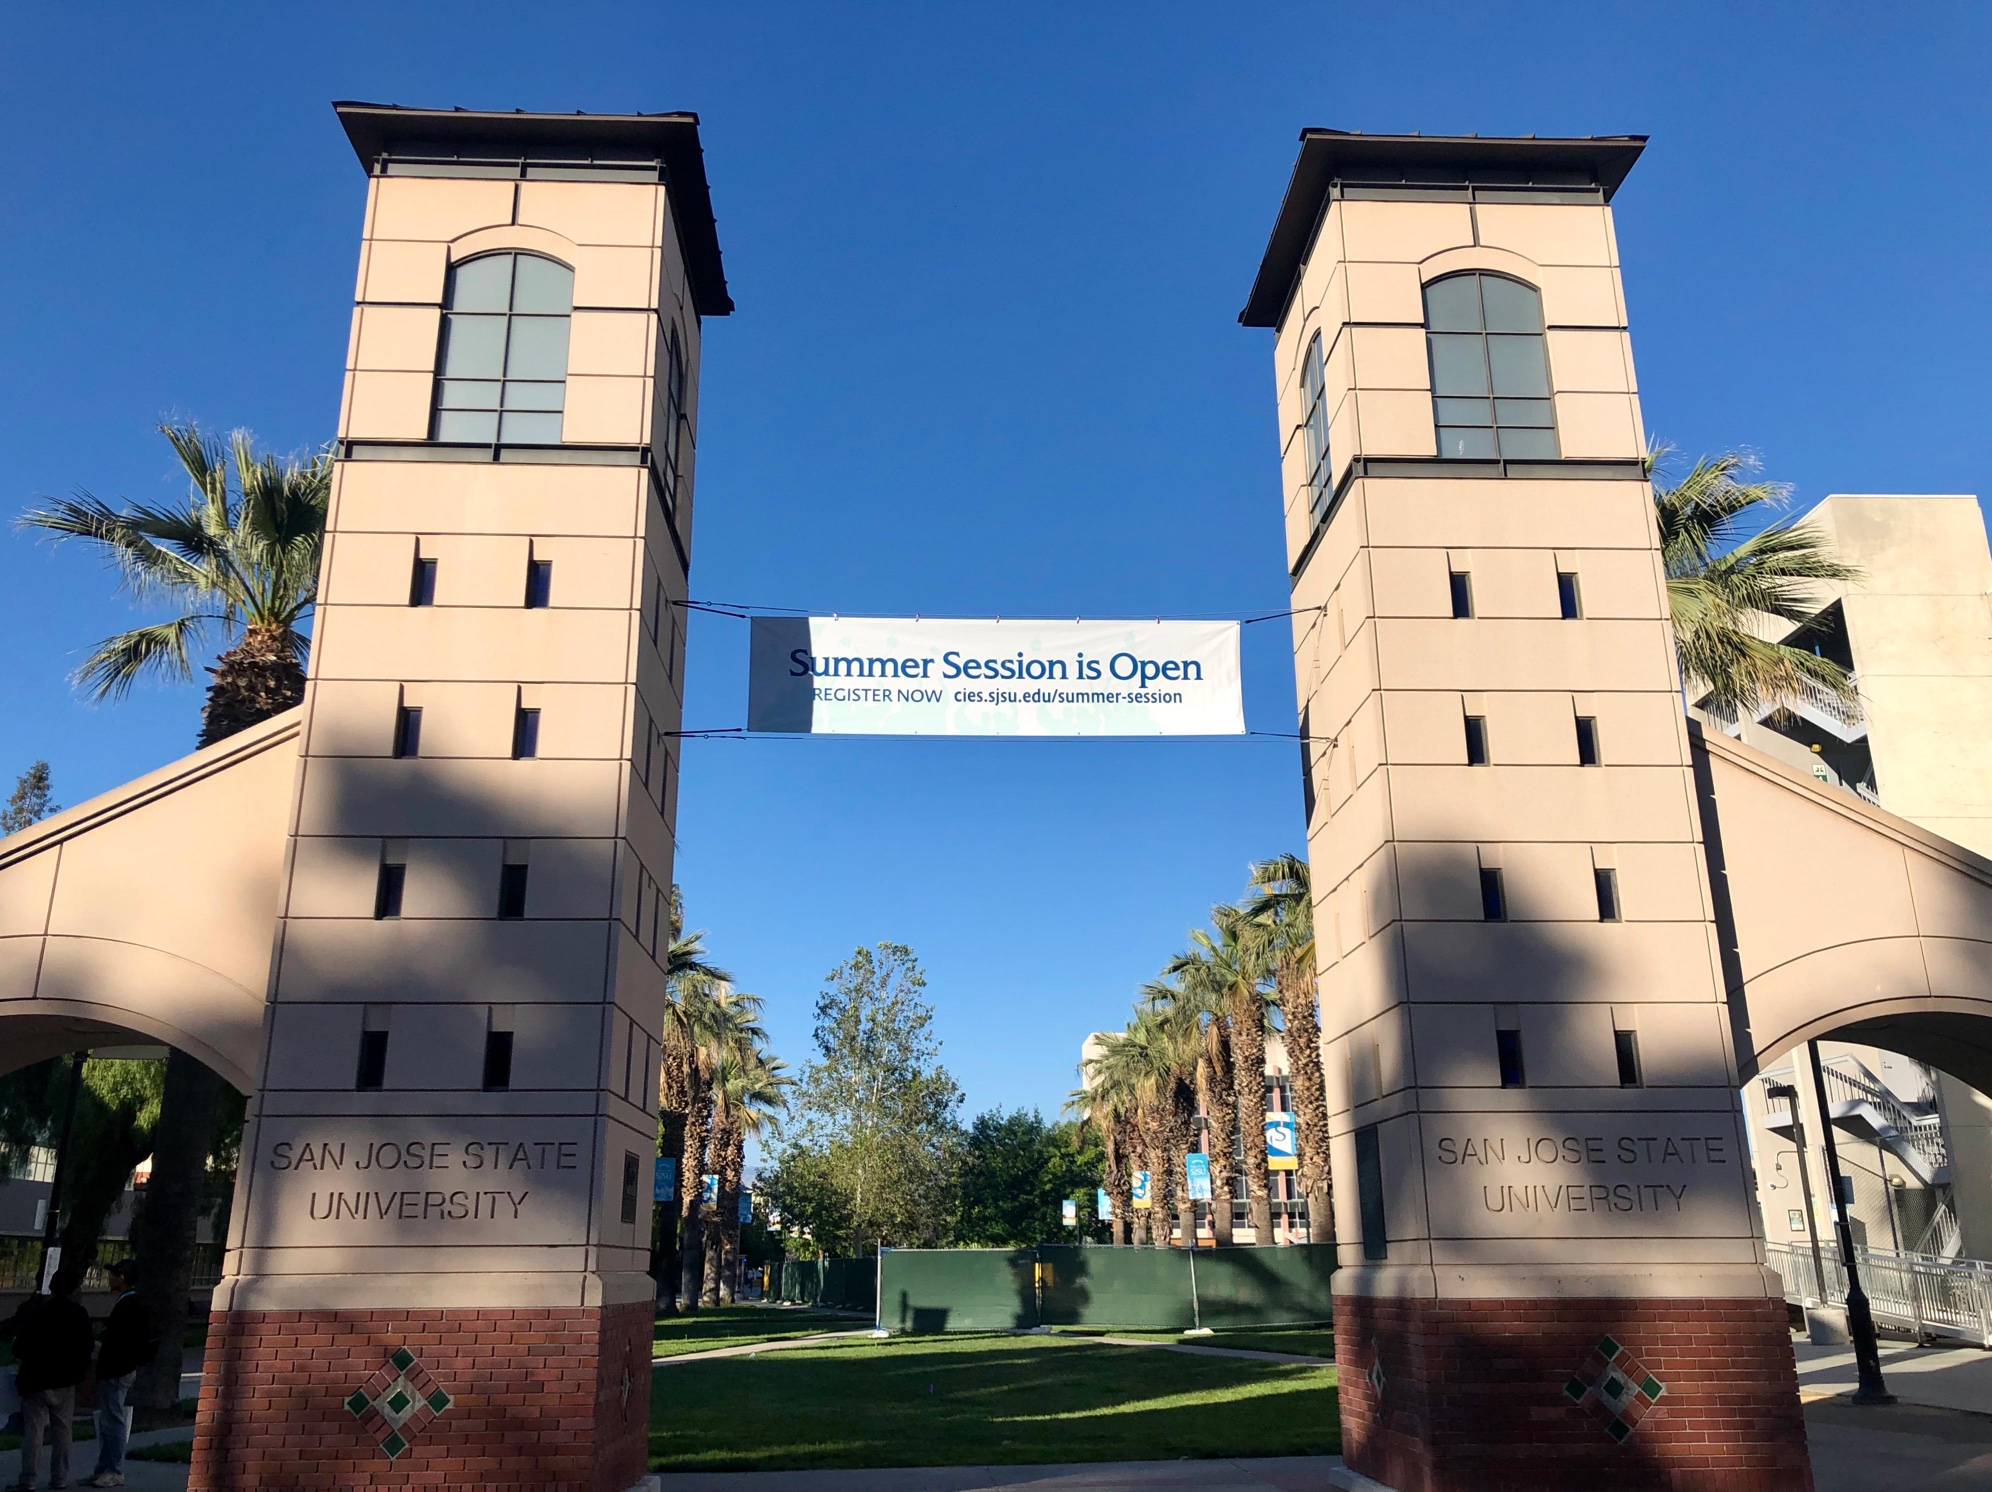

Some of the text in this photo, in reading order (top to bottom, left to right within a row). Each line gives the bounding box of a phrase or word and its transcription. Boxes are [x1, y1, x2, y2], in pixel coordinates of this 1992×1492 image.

[789, 648, 1204, 689] Summer Session is Open
[812, 687, 1183, 706] REGISTER NOW cies.sjsu.edu/summer-session
[270, 1141, 579, 1171] SAN JOSE STATE
[1438, 1136, 1727, 1165] SAN JOSE STATE
[310, 1190, 530, 1220] UNIVERSITY
[1483, 1184, 1688, 1213] UNIVERSITY
